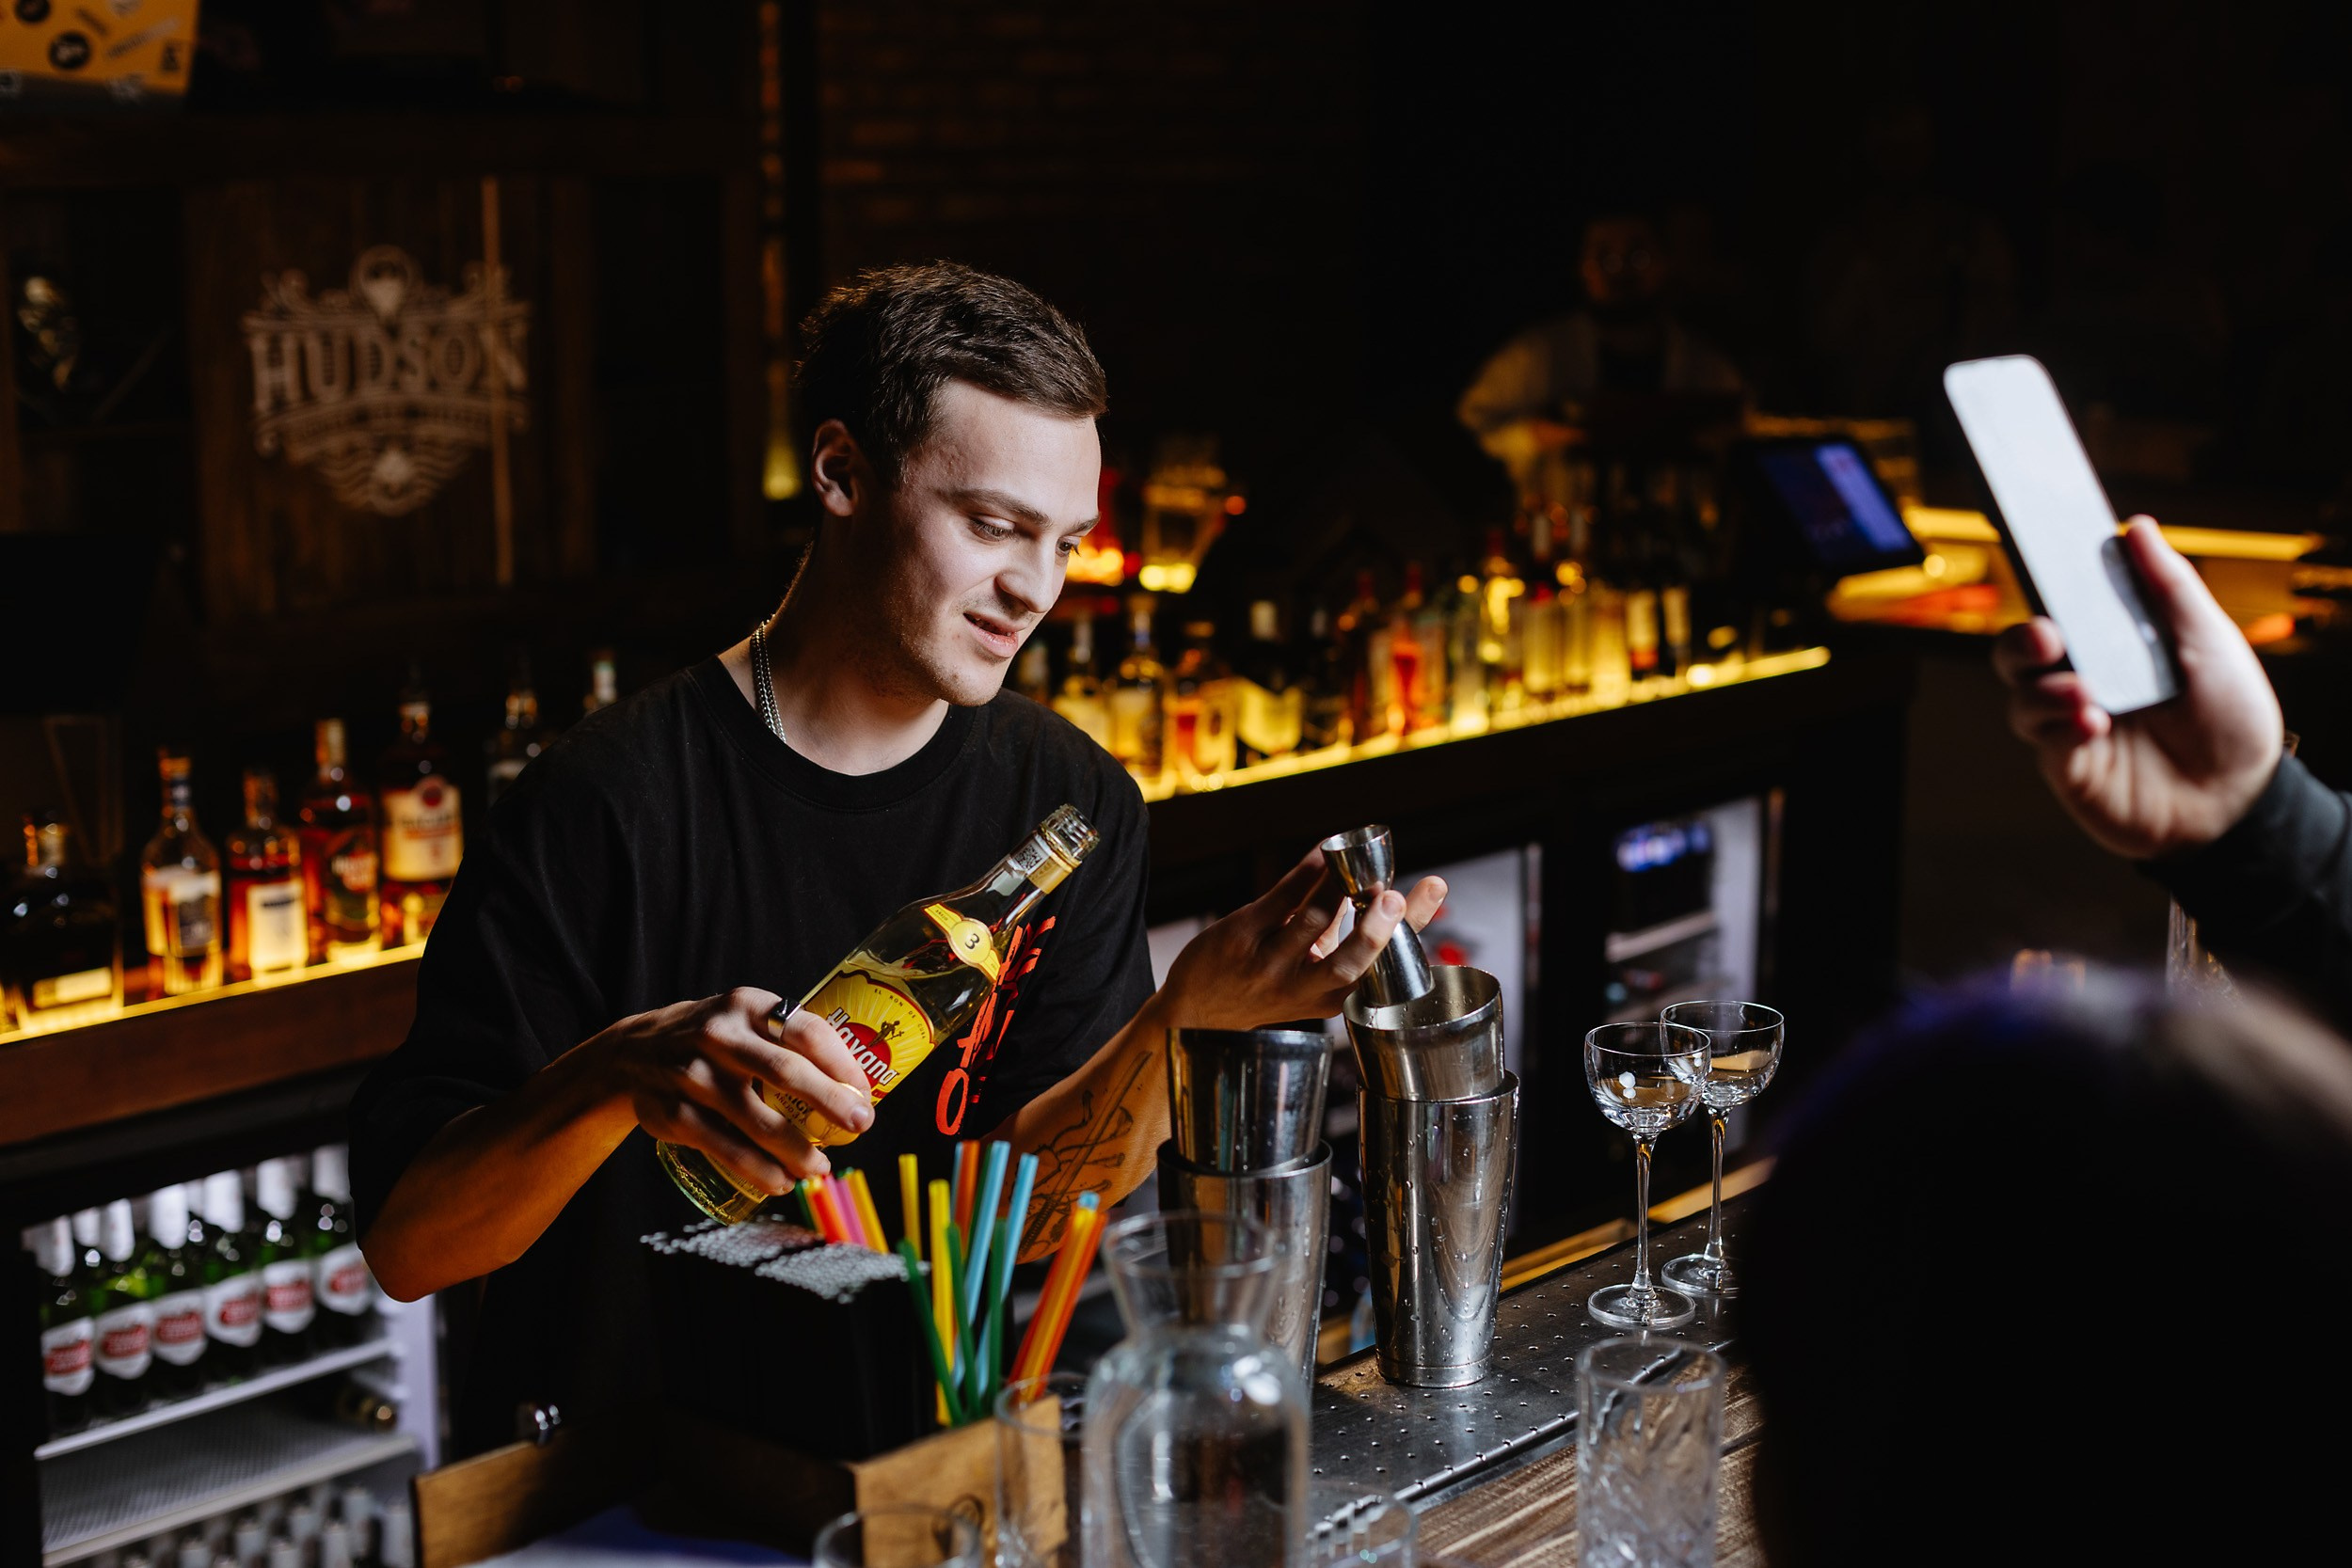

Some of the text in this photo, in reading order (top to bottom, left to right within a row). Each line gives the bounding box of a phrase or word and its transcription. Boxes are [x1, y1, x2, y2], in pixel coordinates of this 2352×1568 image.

[249, 325, 529, 415] HUDSON
[964, 933, 980, 950] 3
[889, 995, 904, 1007] RON
[908, 1010, 916, 1019] DE
[917, 1023, 927, 1039] CUBA
[826, 1006, 900, 1086] Havana
[774, 1092, 795, 1113] AÑEJO
